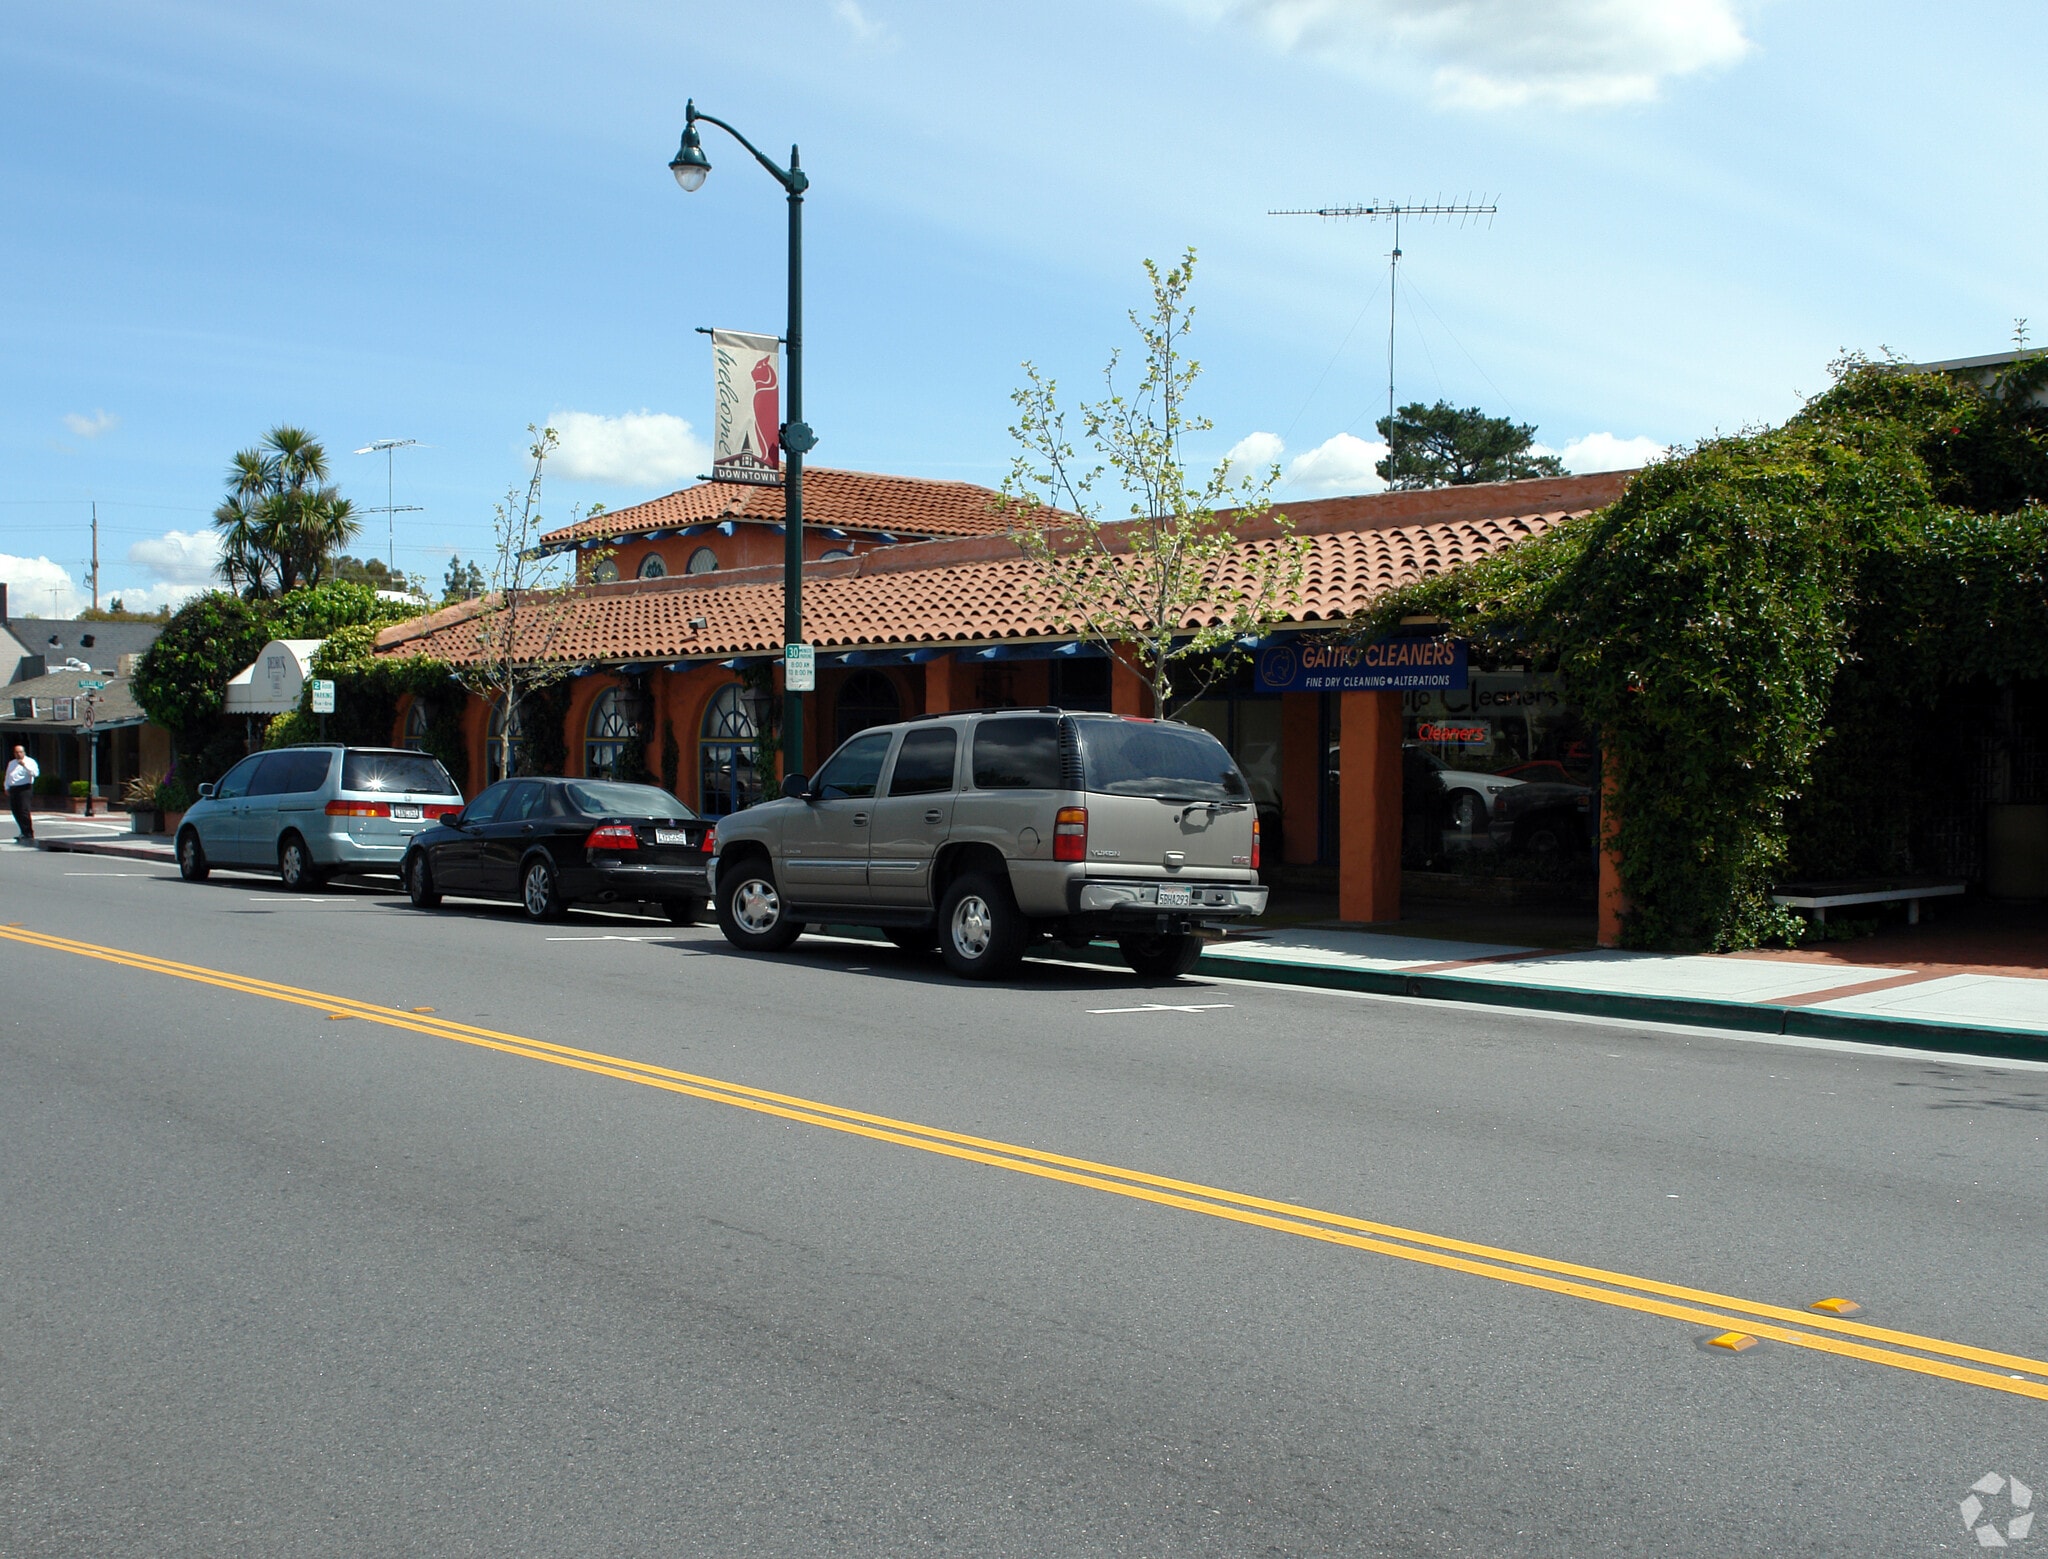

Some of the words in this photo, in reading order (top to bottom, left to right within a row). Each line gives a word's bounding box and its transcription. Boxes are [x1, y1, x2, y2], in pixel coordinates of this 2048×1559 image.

[716, 348, 739, 456] Welcome
[718, 468, 776, 483] DOWNTOWN
[789, 647, 798, 658] 30
[1365, 641, 1456, 668] CLEANERS
[314, 681, 320, 689] 2
[1305, 676, 1323, 688] FINE
[1325, 676, 1341, 688] DRY
[1343, 676, 1386, 688] CLEANING
[1393, 675, 1450, 687] ALTERATIONS
[1440, 679, 1559, 713] Cleaners
[1418, 723, 1485, 742] Cleaners
[1090, 849, 1121, 858] YUKON
